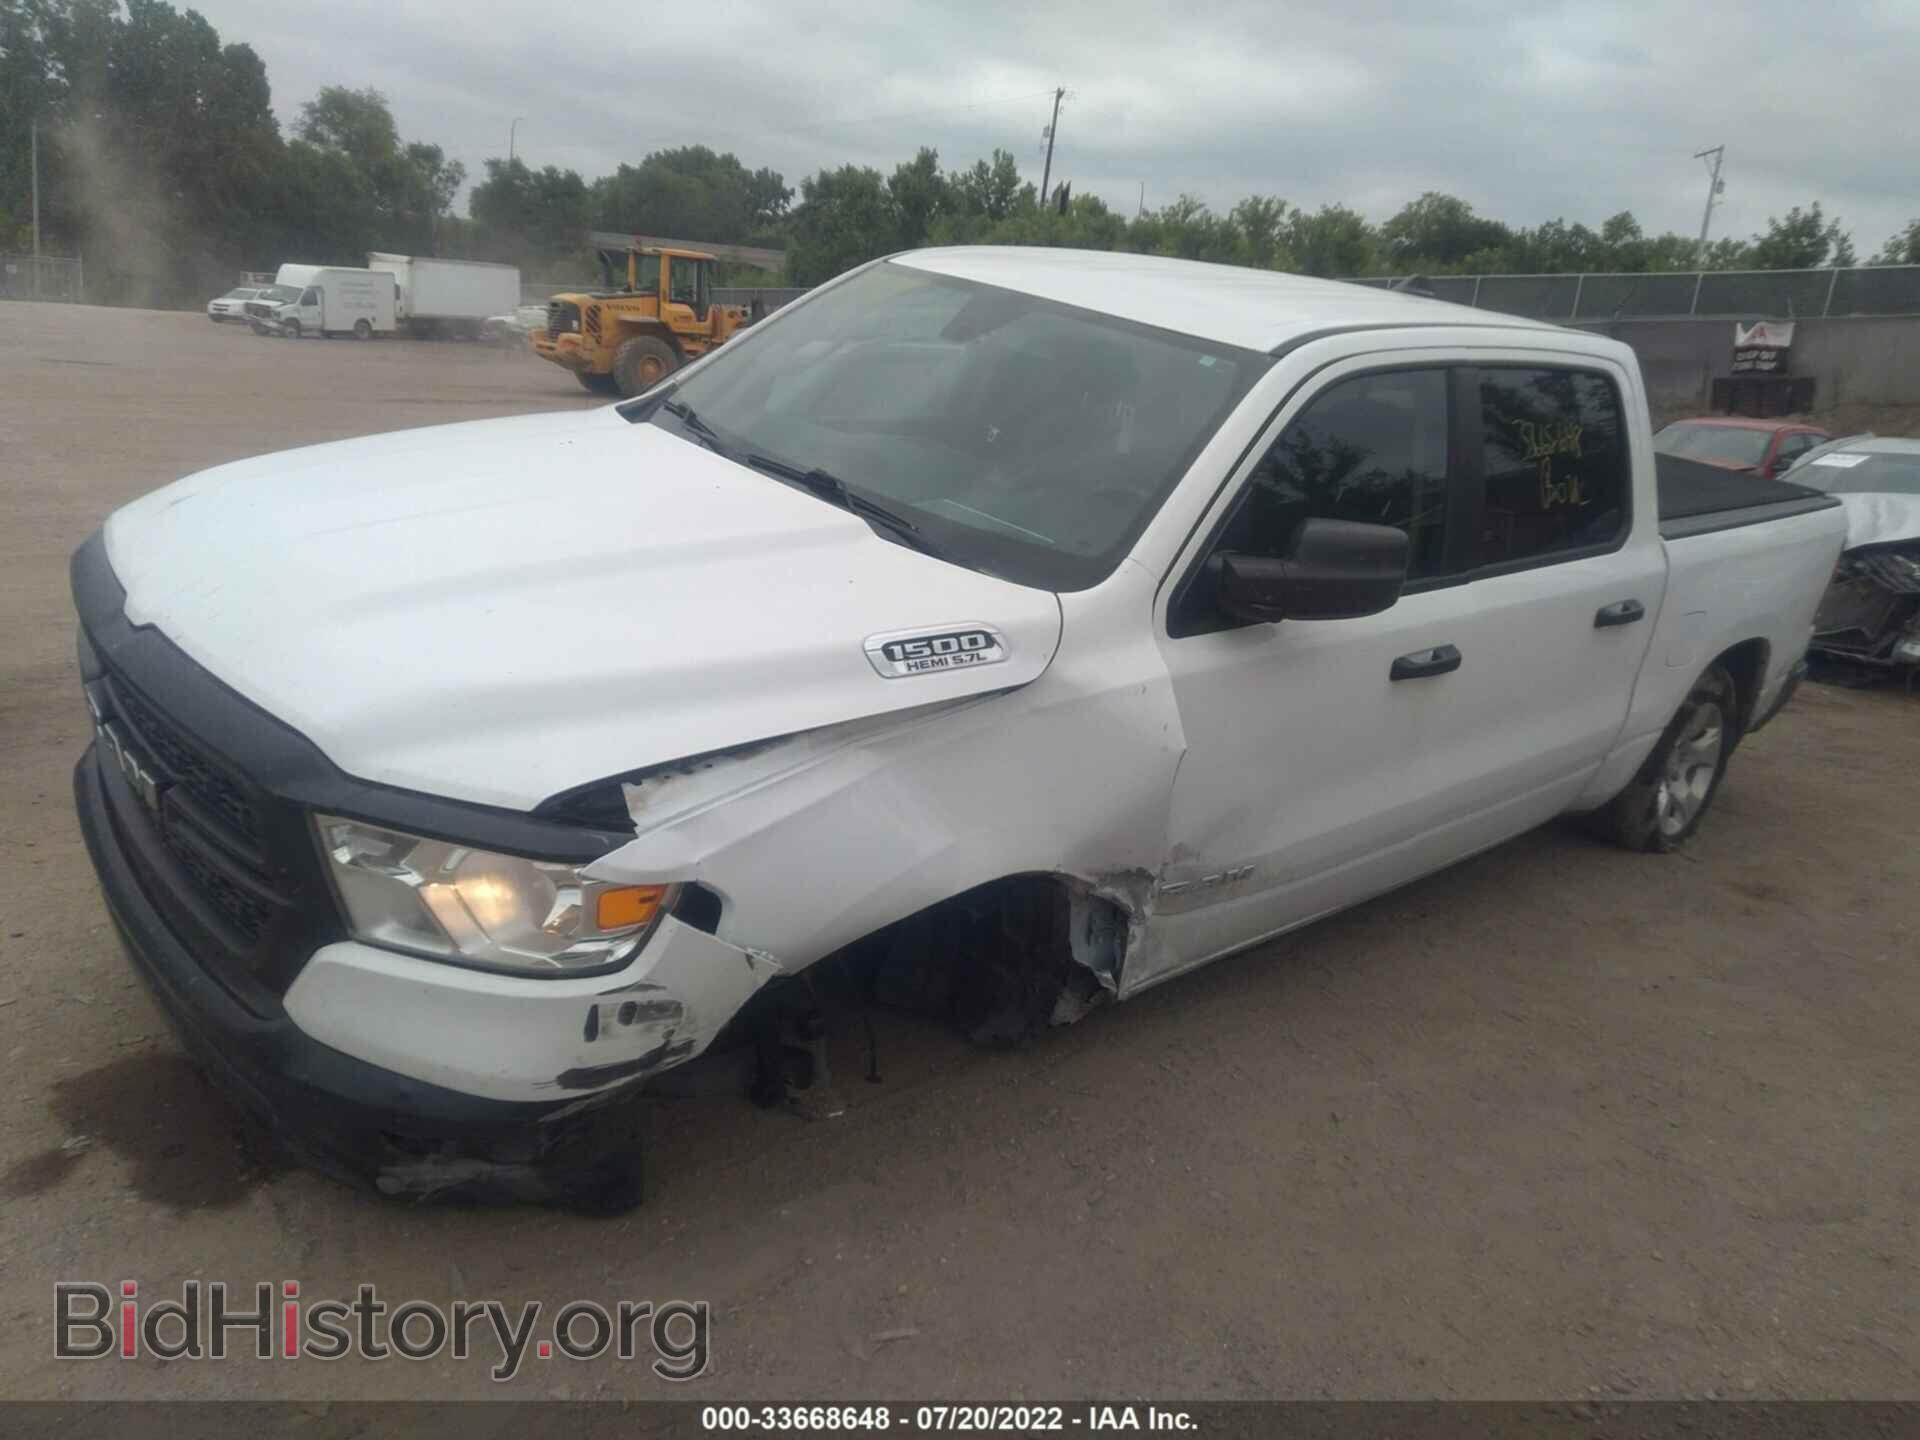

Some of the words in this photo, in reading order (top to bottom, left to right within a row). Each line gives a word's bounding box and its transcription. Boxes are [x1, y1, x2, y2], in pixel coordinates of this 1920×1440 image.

[889, 633, 986, 662] 1500
[905, 655, 949, 672] HEMI
[951, 652, 987, 666] 5.7L
